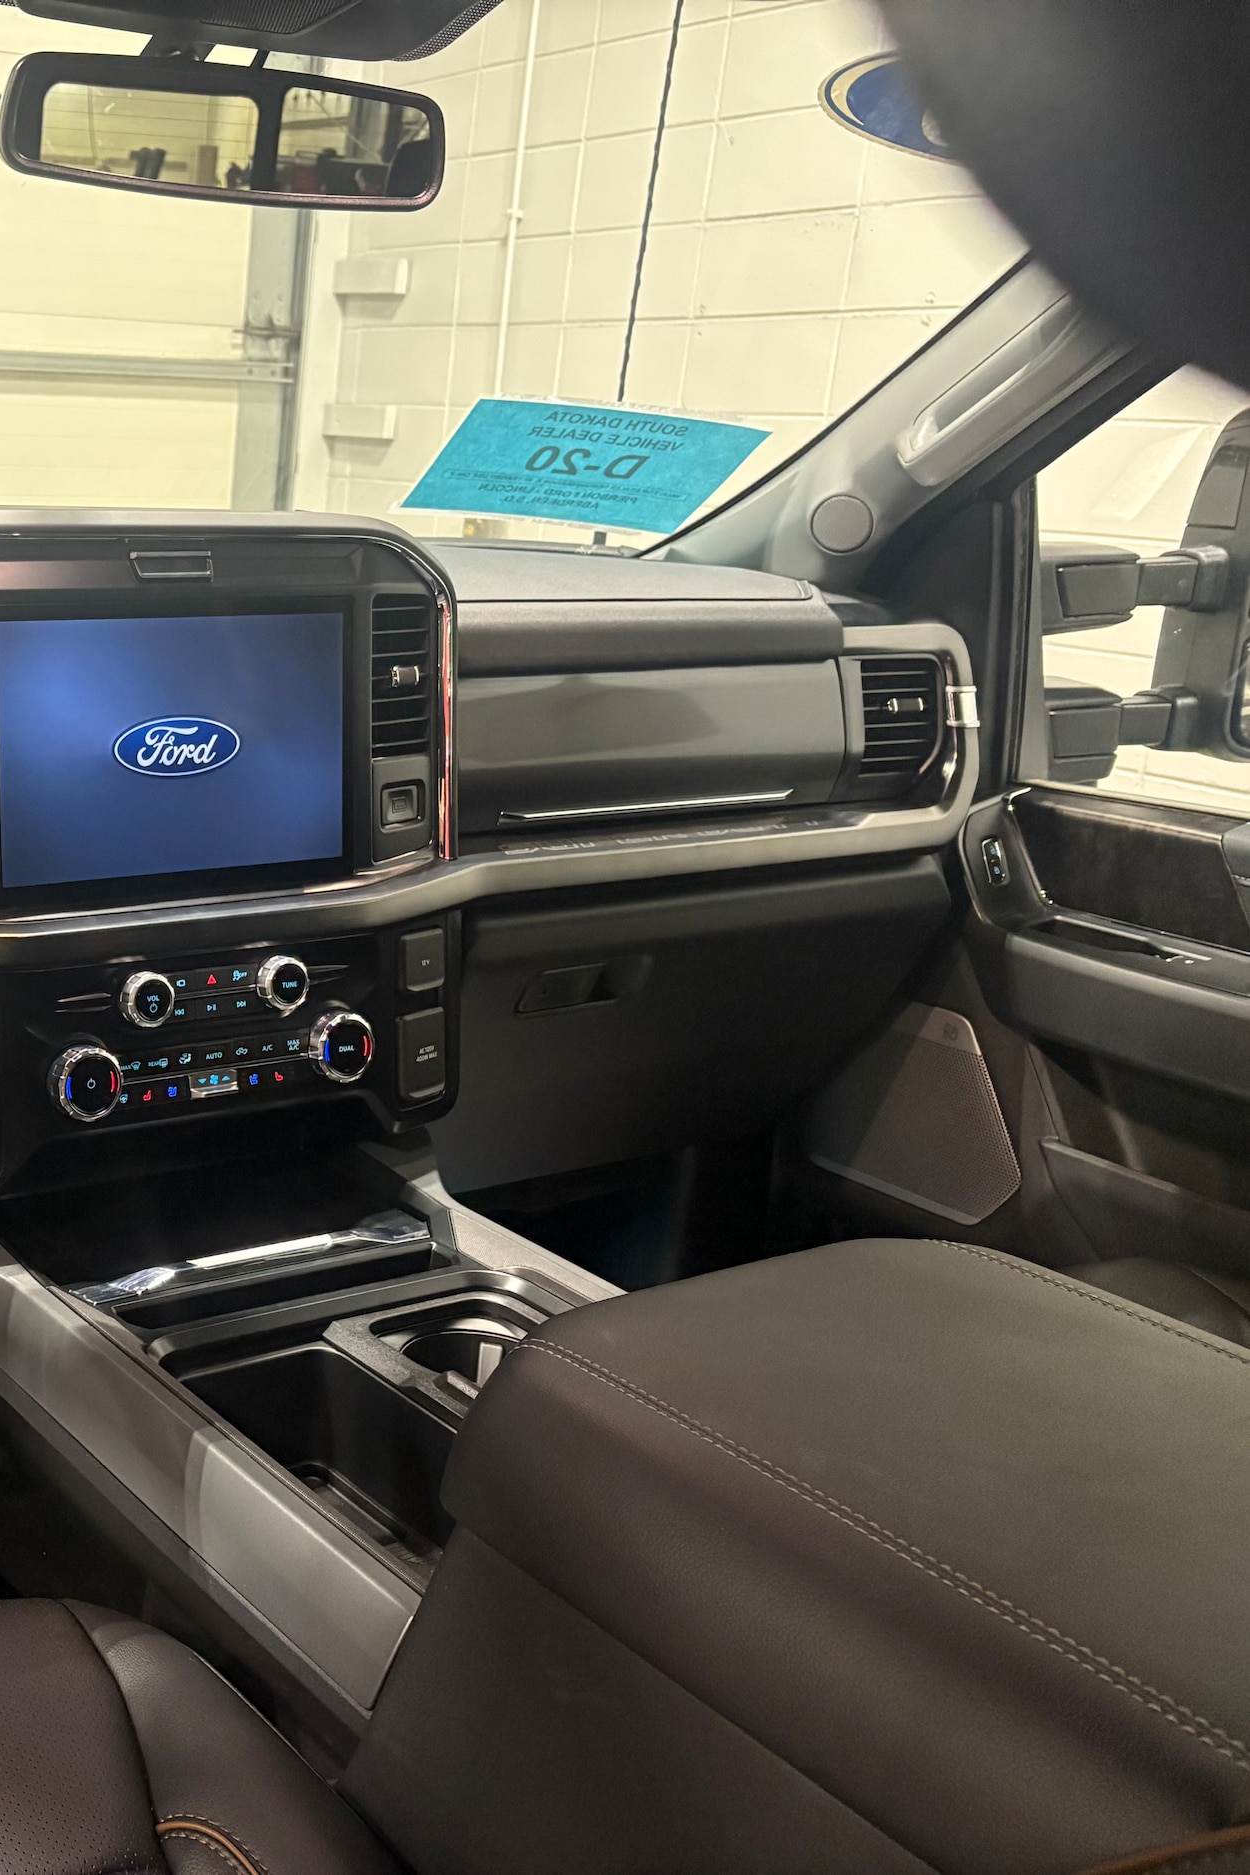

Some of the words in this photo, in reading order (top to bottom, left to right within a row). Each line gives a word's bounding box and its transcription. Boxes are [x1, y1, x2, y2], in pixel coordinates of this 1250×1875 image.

[136, 725, 220, 768] Ford
[281, 981, 298, 989] TUNE
[261, 1044, 274, 1052] A/C
[338, 1044, 355, 1052] DUAL
[205, 1051, 223, 1060] AUTO
